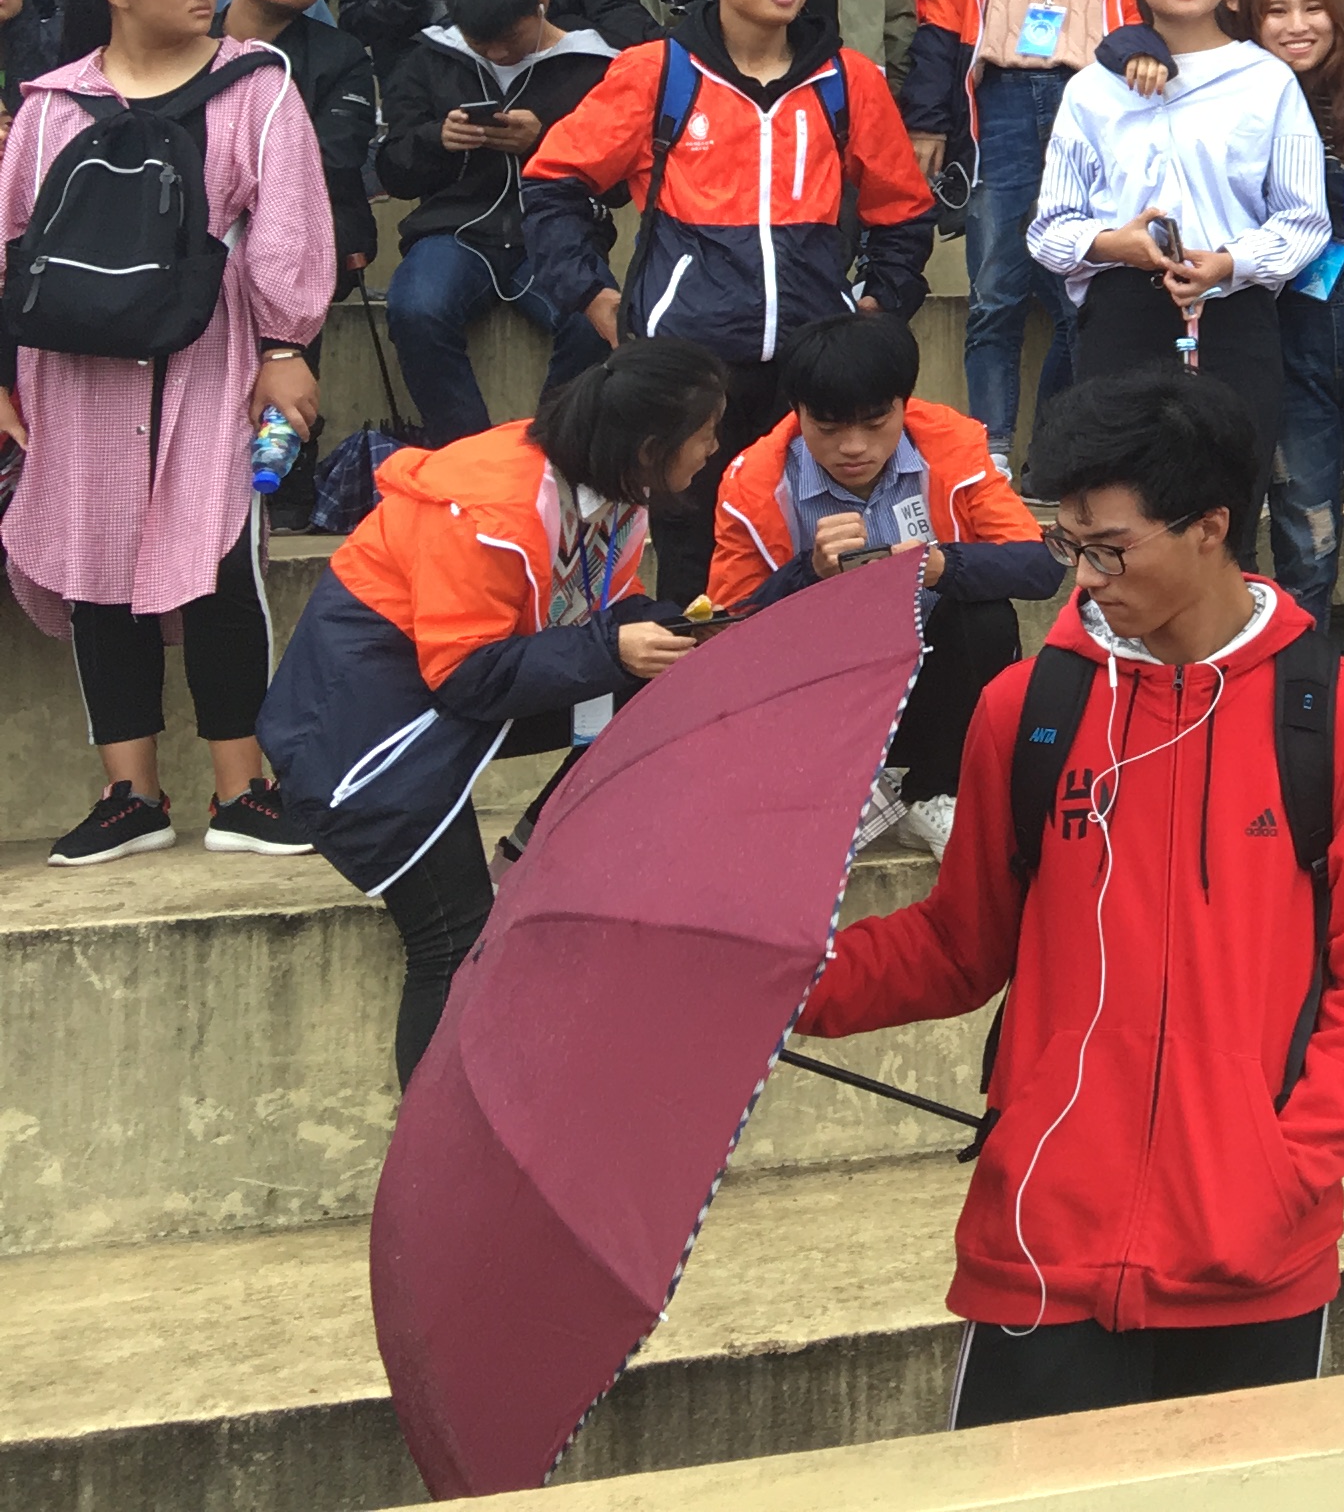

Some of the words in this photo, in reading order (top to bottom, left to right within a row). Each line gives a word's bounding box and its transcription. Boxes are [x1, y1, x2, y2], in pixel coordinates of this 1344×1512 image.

[901, 500, 924, 520] WE
[907, 519, 930, 537] OB
[1029, 727, 1058, 745] ANTA
